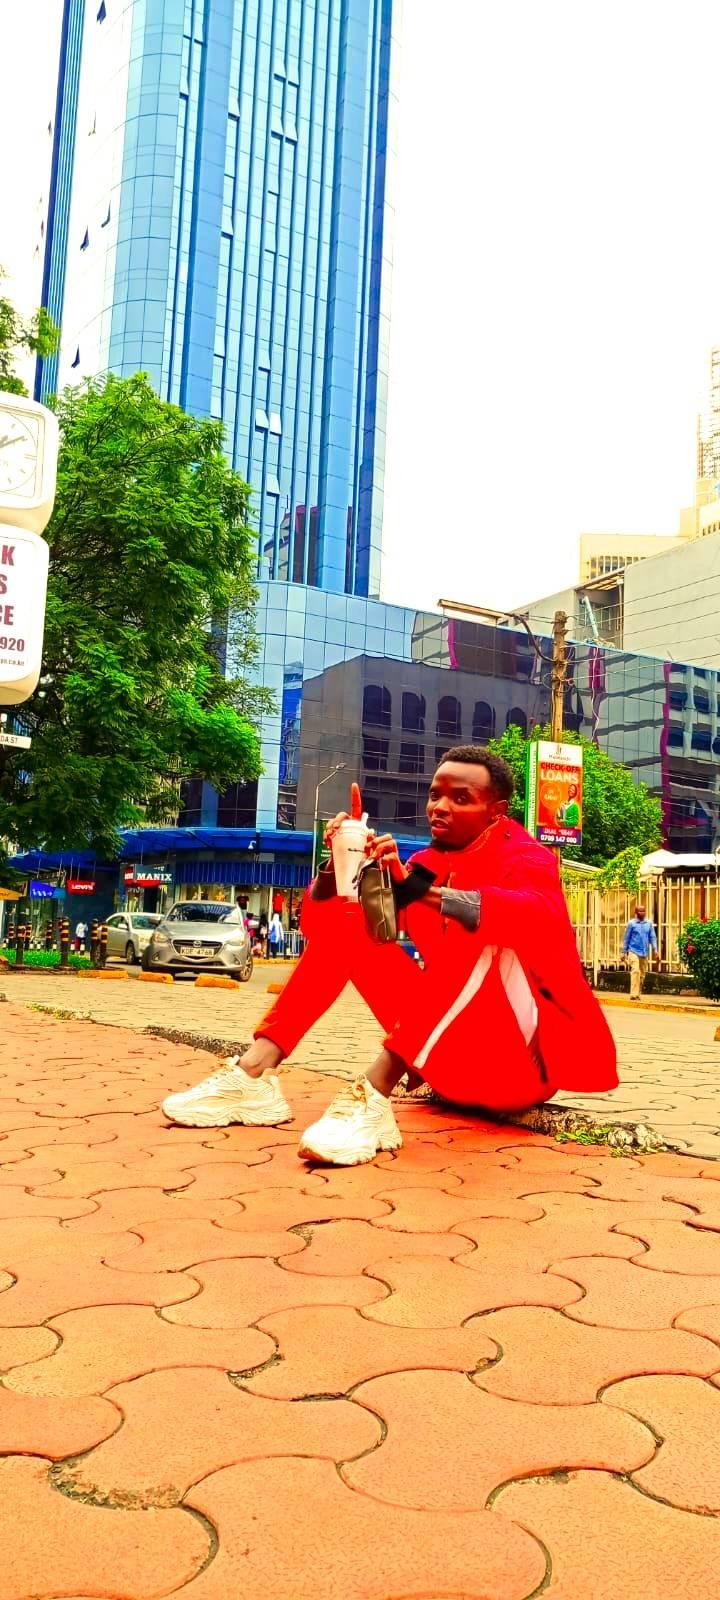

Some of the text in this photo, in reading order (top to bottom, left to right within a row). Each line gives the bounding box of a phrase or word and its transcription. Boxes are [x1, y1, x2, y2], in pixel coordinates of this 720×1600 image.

[1, 545, 15, 566] K
[0, 605, 14, 626] E
[0, 637, 25, 652] 920
[540, 762, 581, 773] CHECK-OFF
[541, 770, 579, 785] LOANS
[137, 873, 172, 881] MANIX
